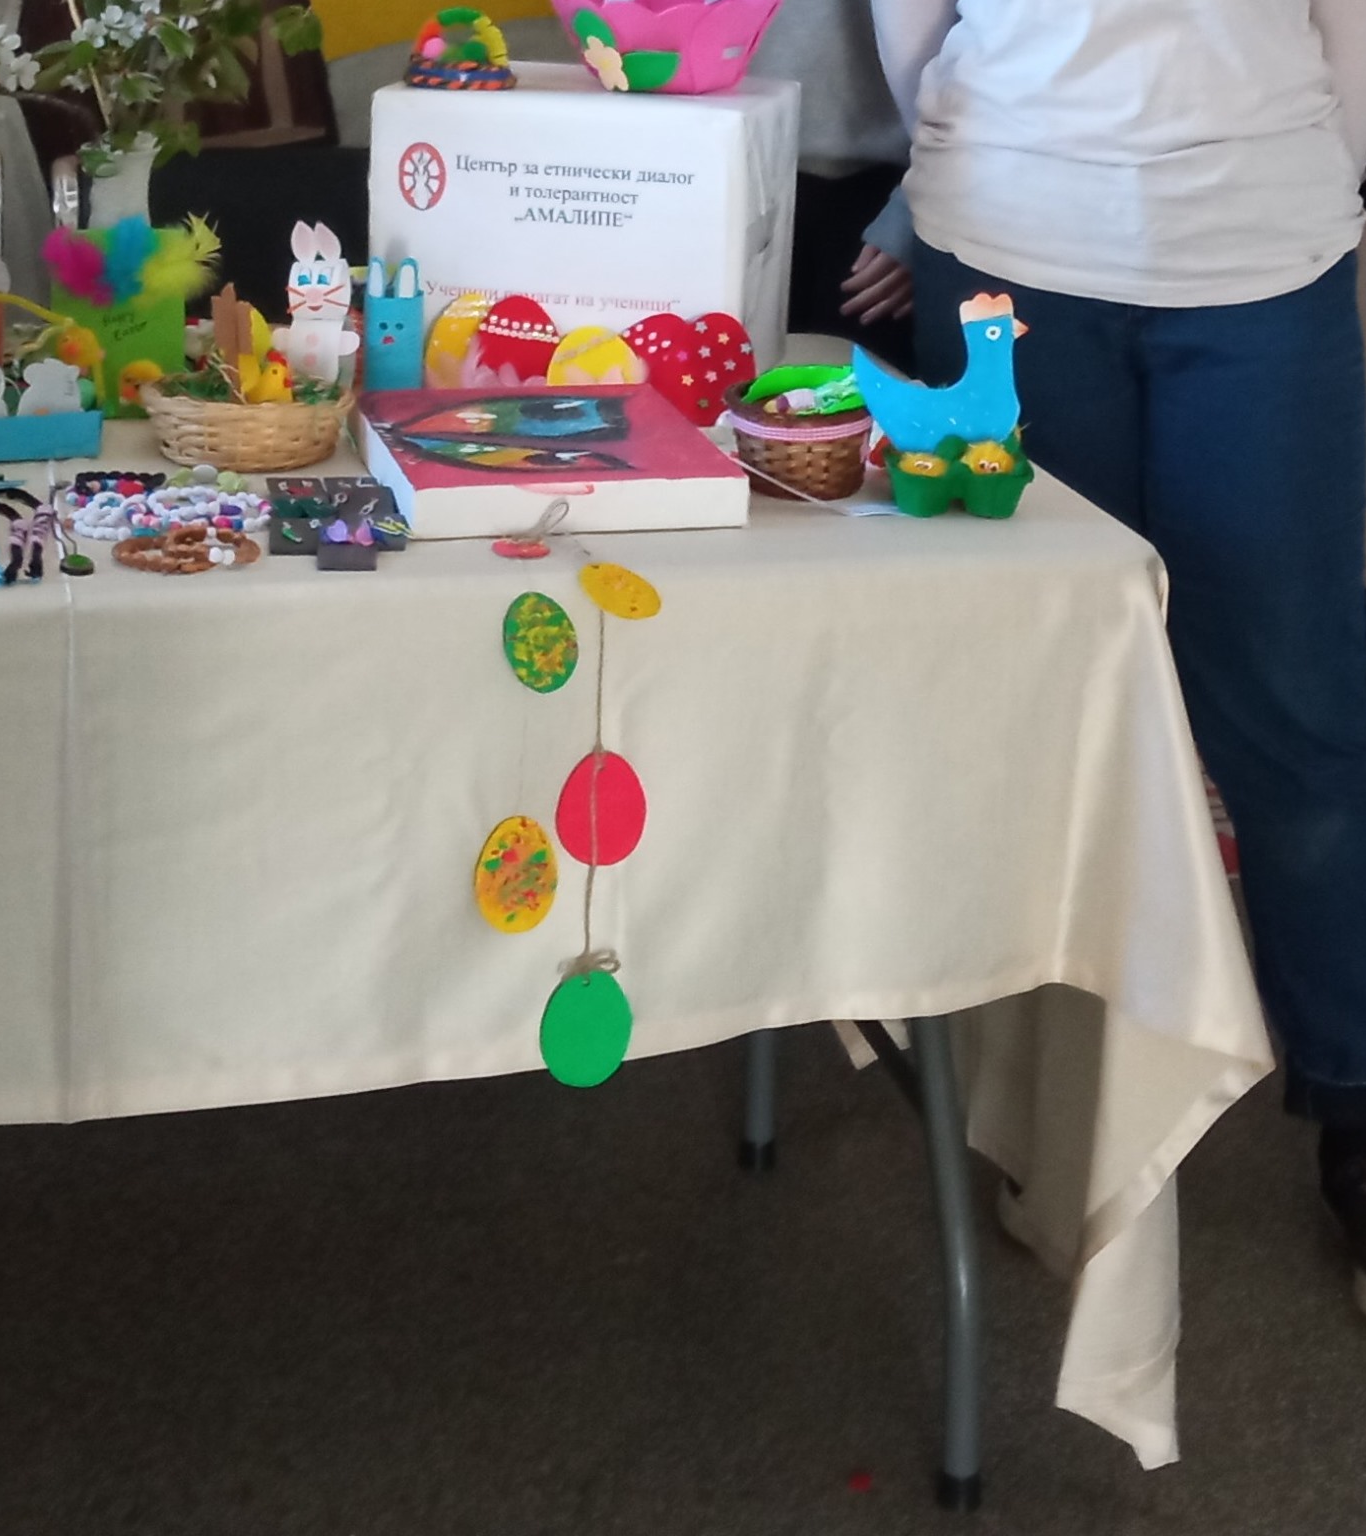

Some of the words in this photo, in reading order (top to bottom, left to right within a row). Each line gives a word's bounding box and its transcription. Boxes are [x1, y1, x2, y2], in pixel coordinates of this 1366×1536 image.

[455, 154, 518, 177] Център
[523, 163, 539, 175] за
[543, 164, 632, 181] етнически
[636, 170, 696, 185] диалог
[509, 186, 520, 197] и
[524, 186, 640, 204] толерантност
[575, 294, 595, 307] на
